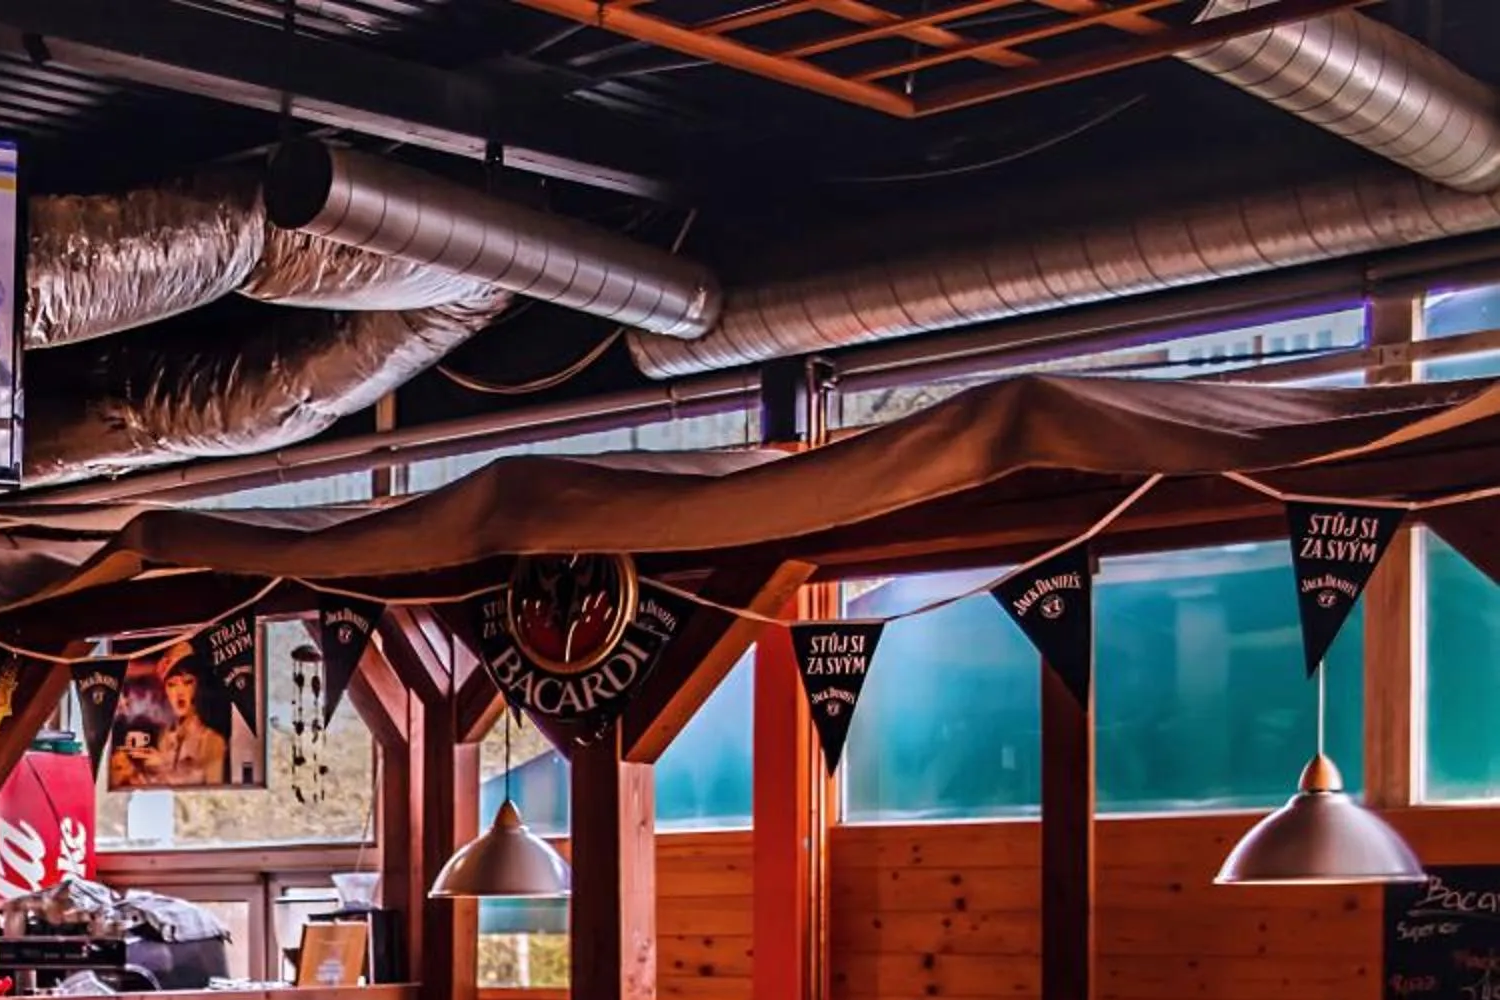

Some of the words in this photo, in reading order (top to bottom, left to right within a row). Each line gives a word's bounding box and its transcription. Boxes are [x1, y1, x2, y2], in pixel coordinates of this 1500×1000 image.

[1308, 511, 1358, 537] STŮJ
[1360, 517, 1379, 539] SI
[1300, 537, 1322, 559] ZA
[1325, 537, 1377, 563] SVÝM
[1013, 588, 1039, 616] JACK
[810, 632, 848, 654] STŮJ
[850, 635, 865, 653] SI
[492, 639, 650, 714] BACARDI
[807, 656, 823, 675] ZA
[826, 653, 866, 675] SVÝM
